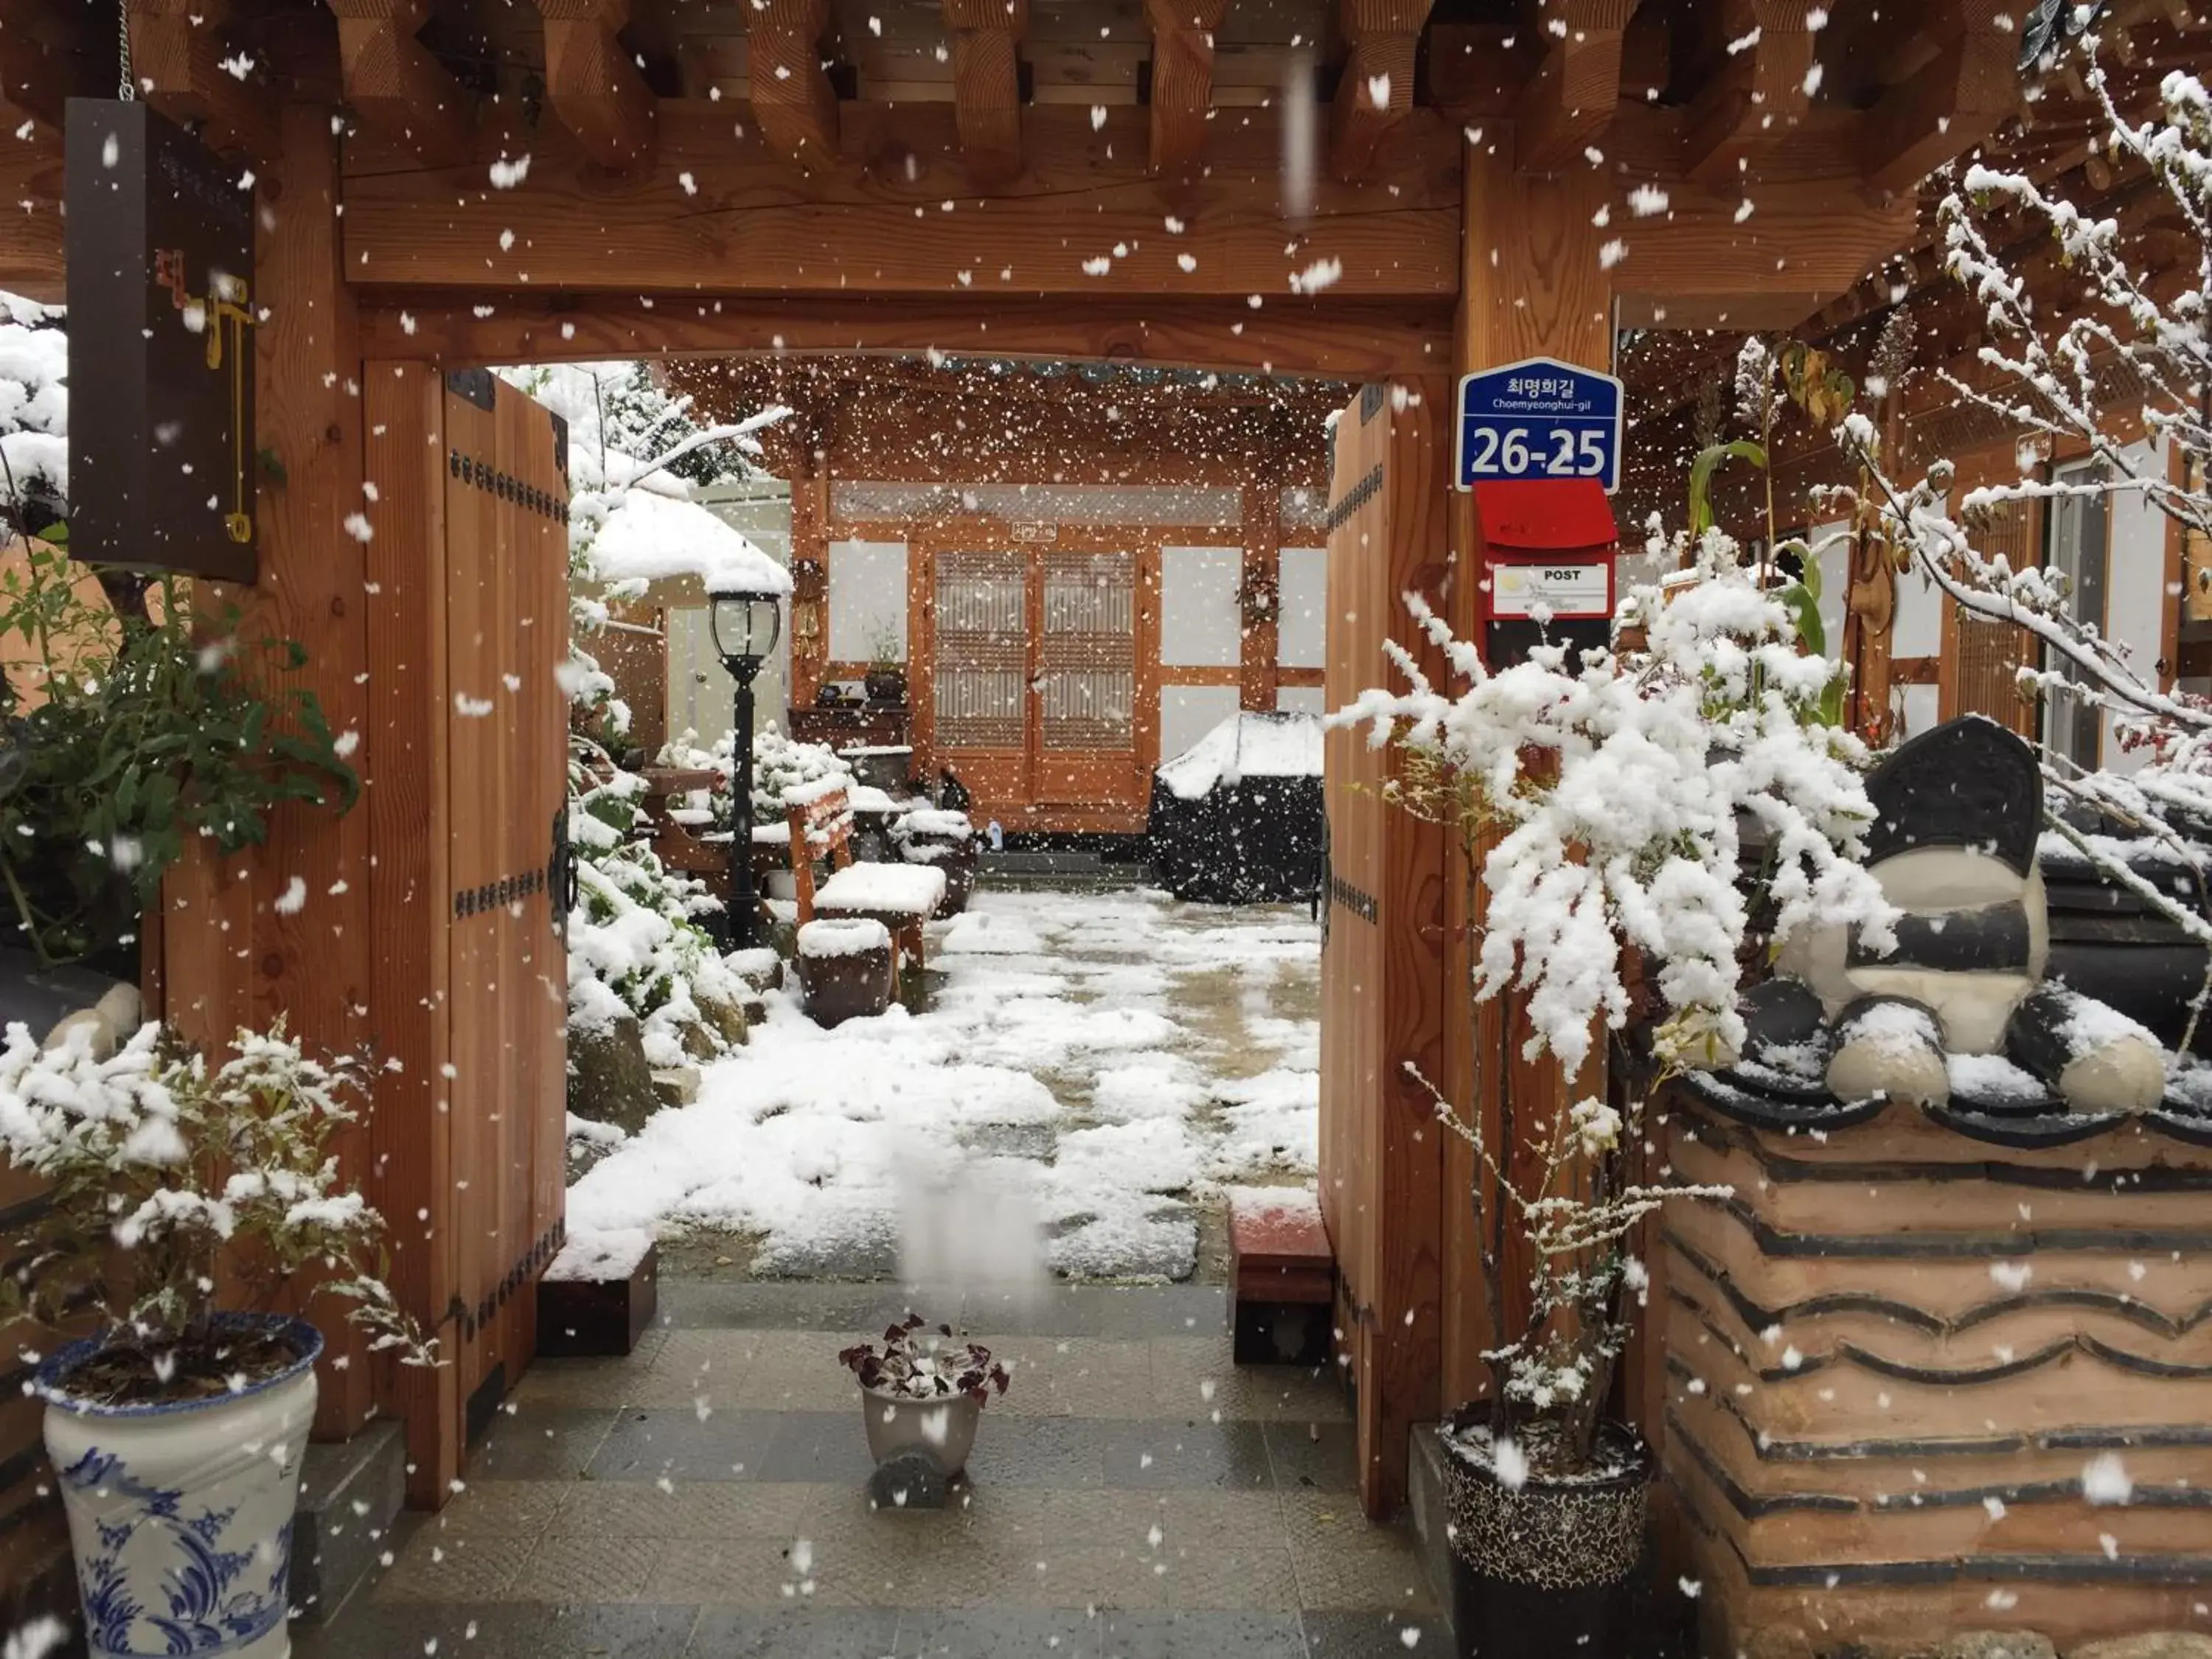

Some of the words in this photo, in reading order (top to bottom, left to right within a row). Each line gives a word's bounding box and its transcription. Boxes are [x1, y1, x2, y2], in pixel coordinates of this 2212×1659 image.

[1507, 378, 1575, 399] 최명희길
[1492, 397, 1591, 411] Choemyeonghui-gil
[1472, 427, 1605, 476] 26-25
[1545, 570, 1581, 580] POST
